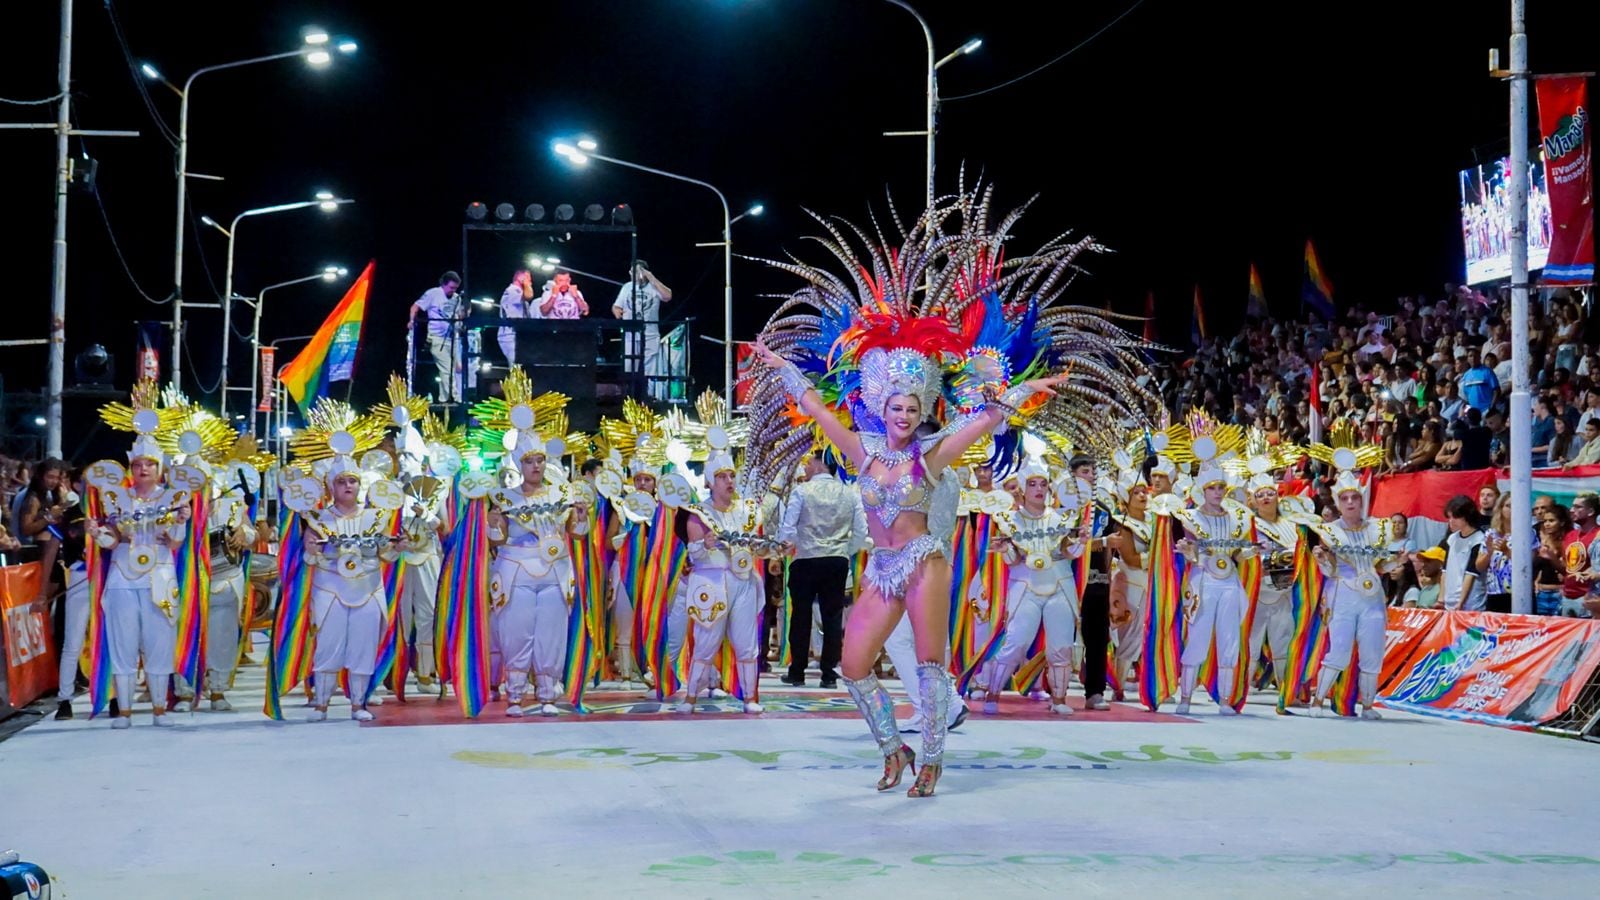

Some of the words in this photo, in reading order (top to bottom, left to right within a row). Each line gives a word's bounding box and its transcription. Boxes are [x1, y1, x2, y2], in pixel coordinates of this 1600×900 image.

[93, 466, 119, 486] BS
[174, 469, 201, 490] BS
[664, 478, 689, 502] BS
